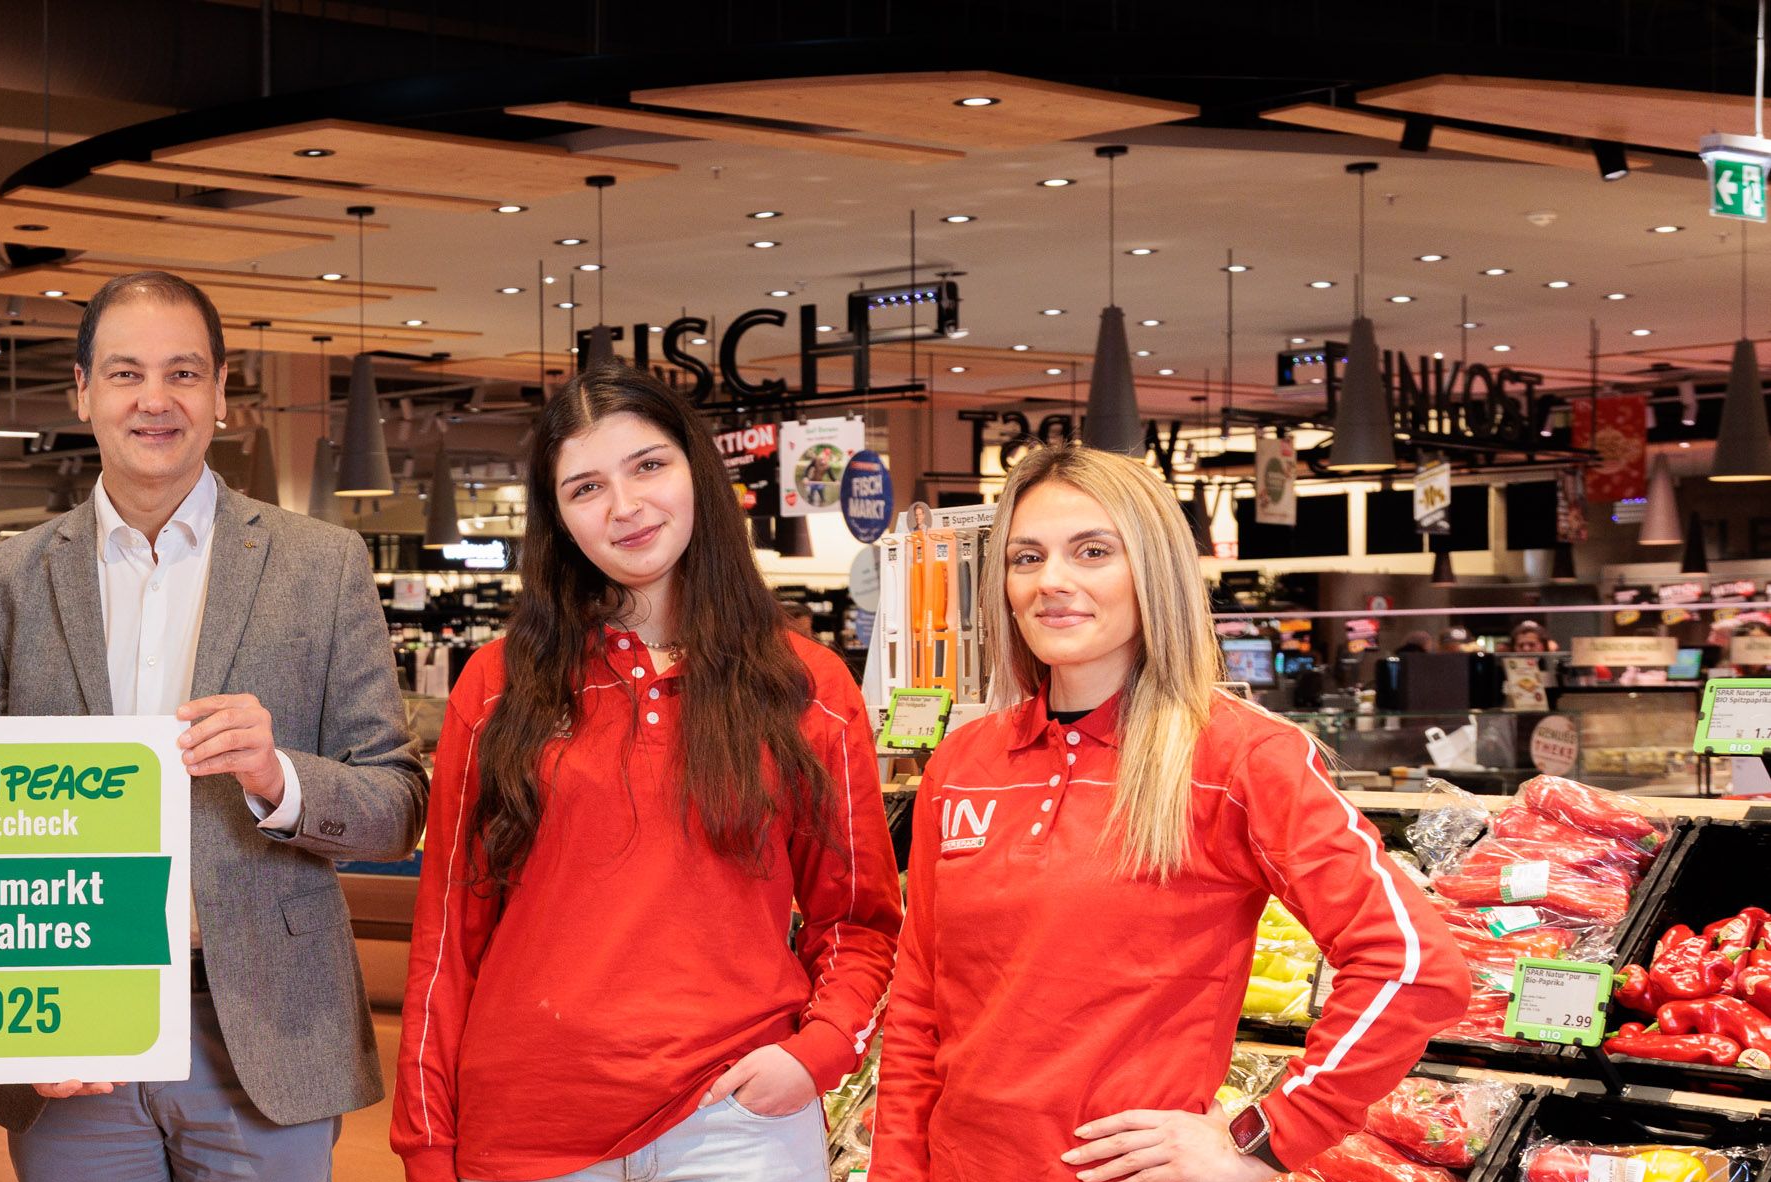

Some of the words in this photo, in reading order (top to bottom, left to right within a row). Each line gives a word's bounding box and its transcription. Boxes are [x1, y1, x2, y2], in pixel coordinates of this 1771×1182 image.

[1326, 341, 1543, 441] FINKOST
[852, 475, 883, 498] FISCH
[848, 498, 886, 520] MARKT
[1755, 727, 1771, 739] 1.7
[1729, 743, 1752, 752] BIO
[942, 798, 997, 839] IN
[1526, 968, 1543, 976] SPAR
[1524, 976, 1565, 987] Bio-Paprika
[1563, 1014, 1592, 1028] 2.99
[1539, 1029, 1561, 1040] BIO
